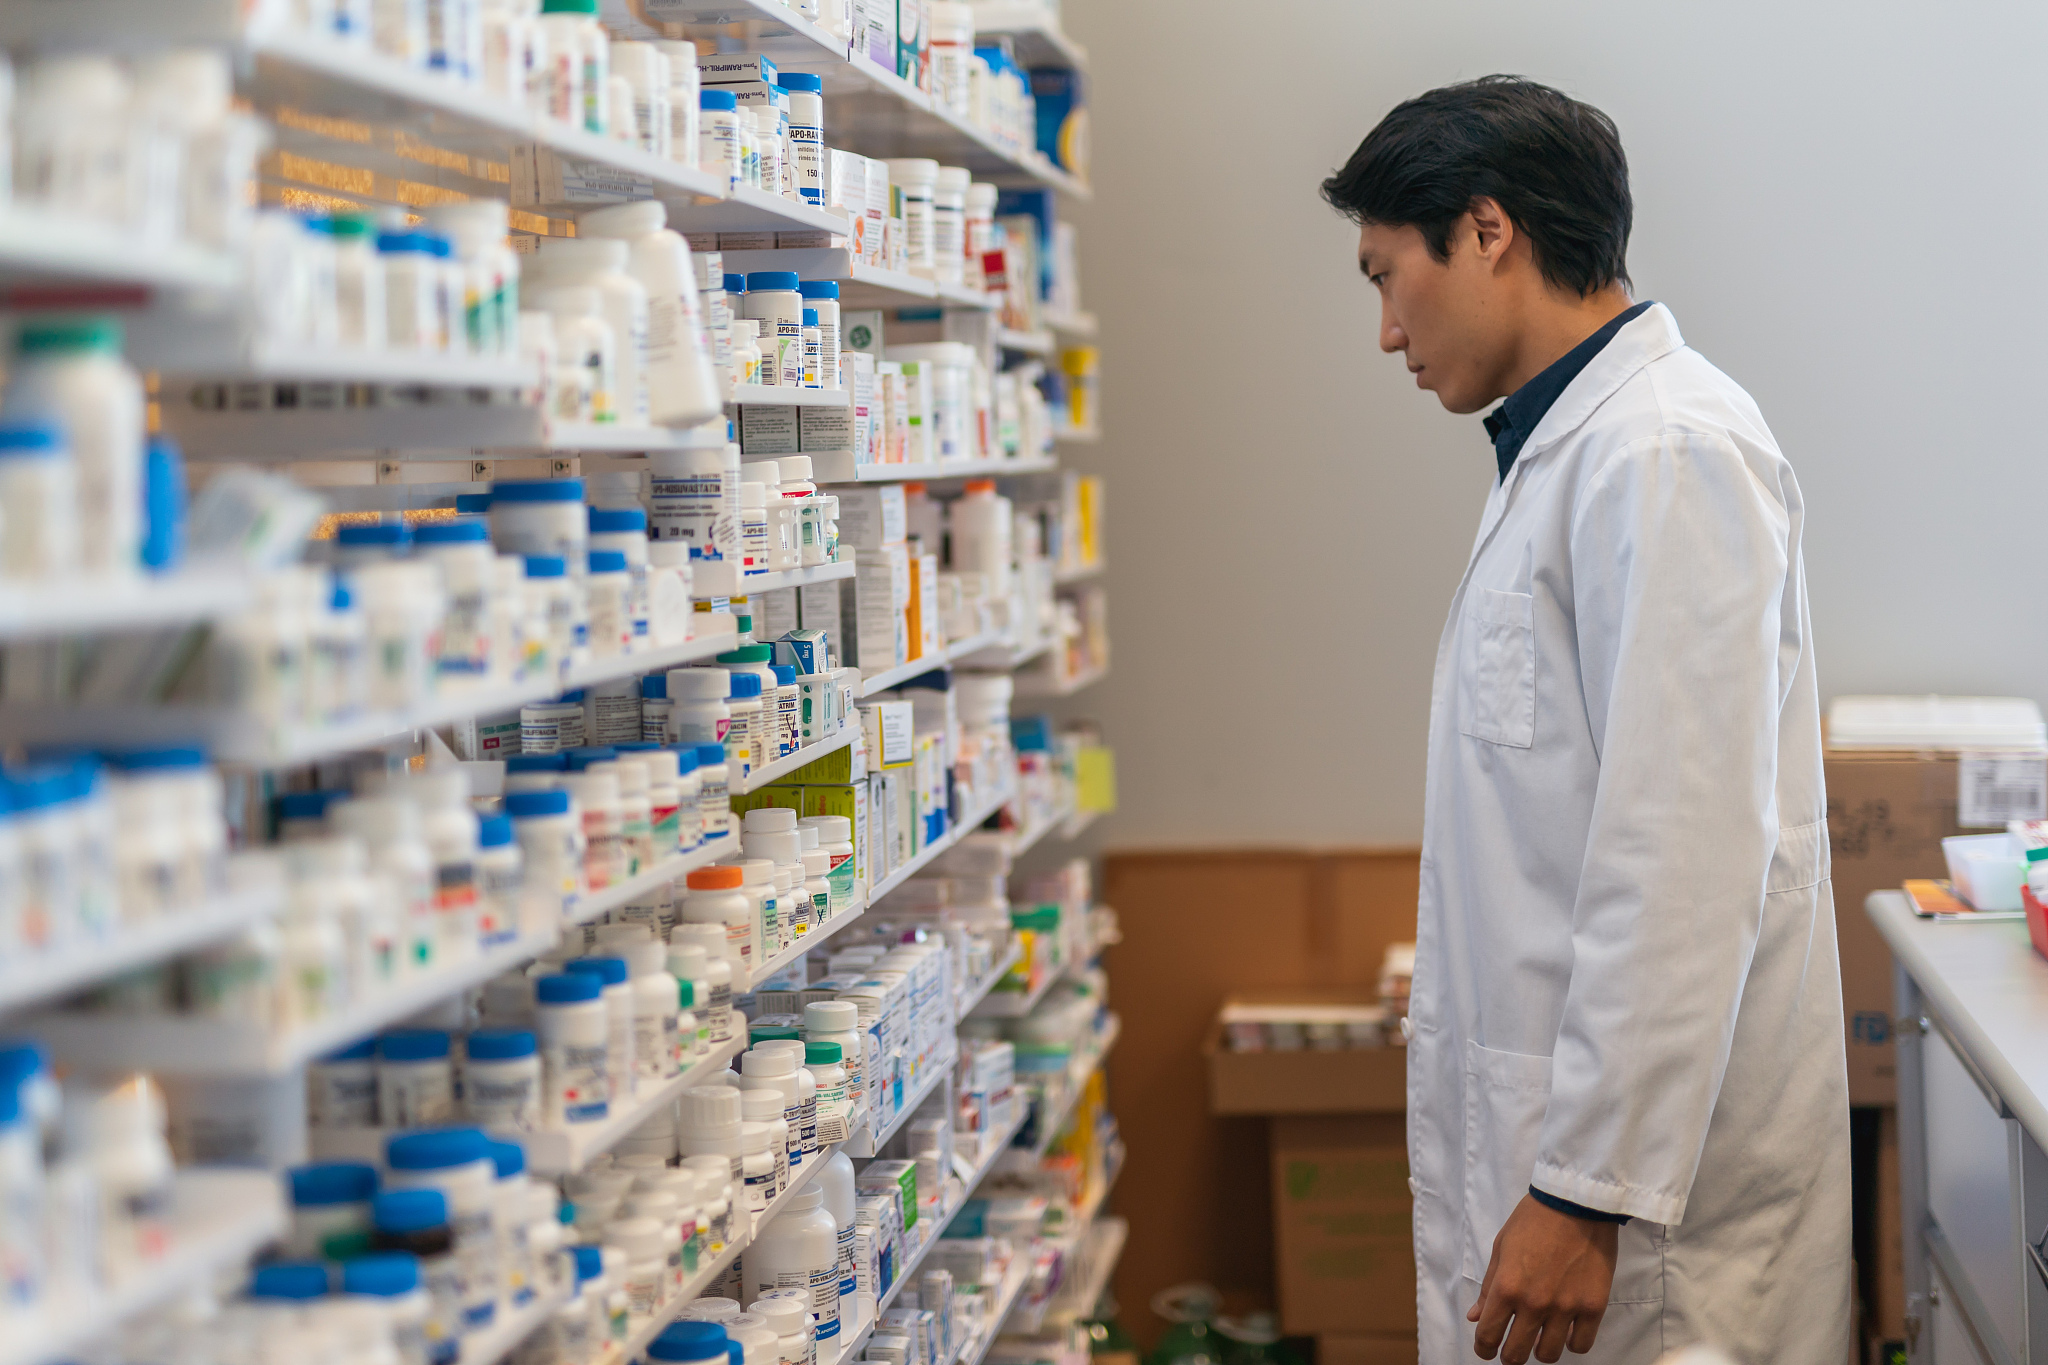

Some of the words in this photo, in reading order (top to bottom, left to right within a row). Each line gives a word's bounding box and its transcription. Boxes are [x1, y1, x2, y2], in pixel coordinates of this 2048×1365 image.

[806, 169, 818, 178] 150
[670, 527, 679, 536] 20
[683, 528, 694, 537] mg
